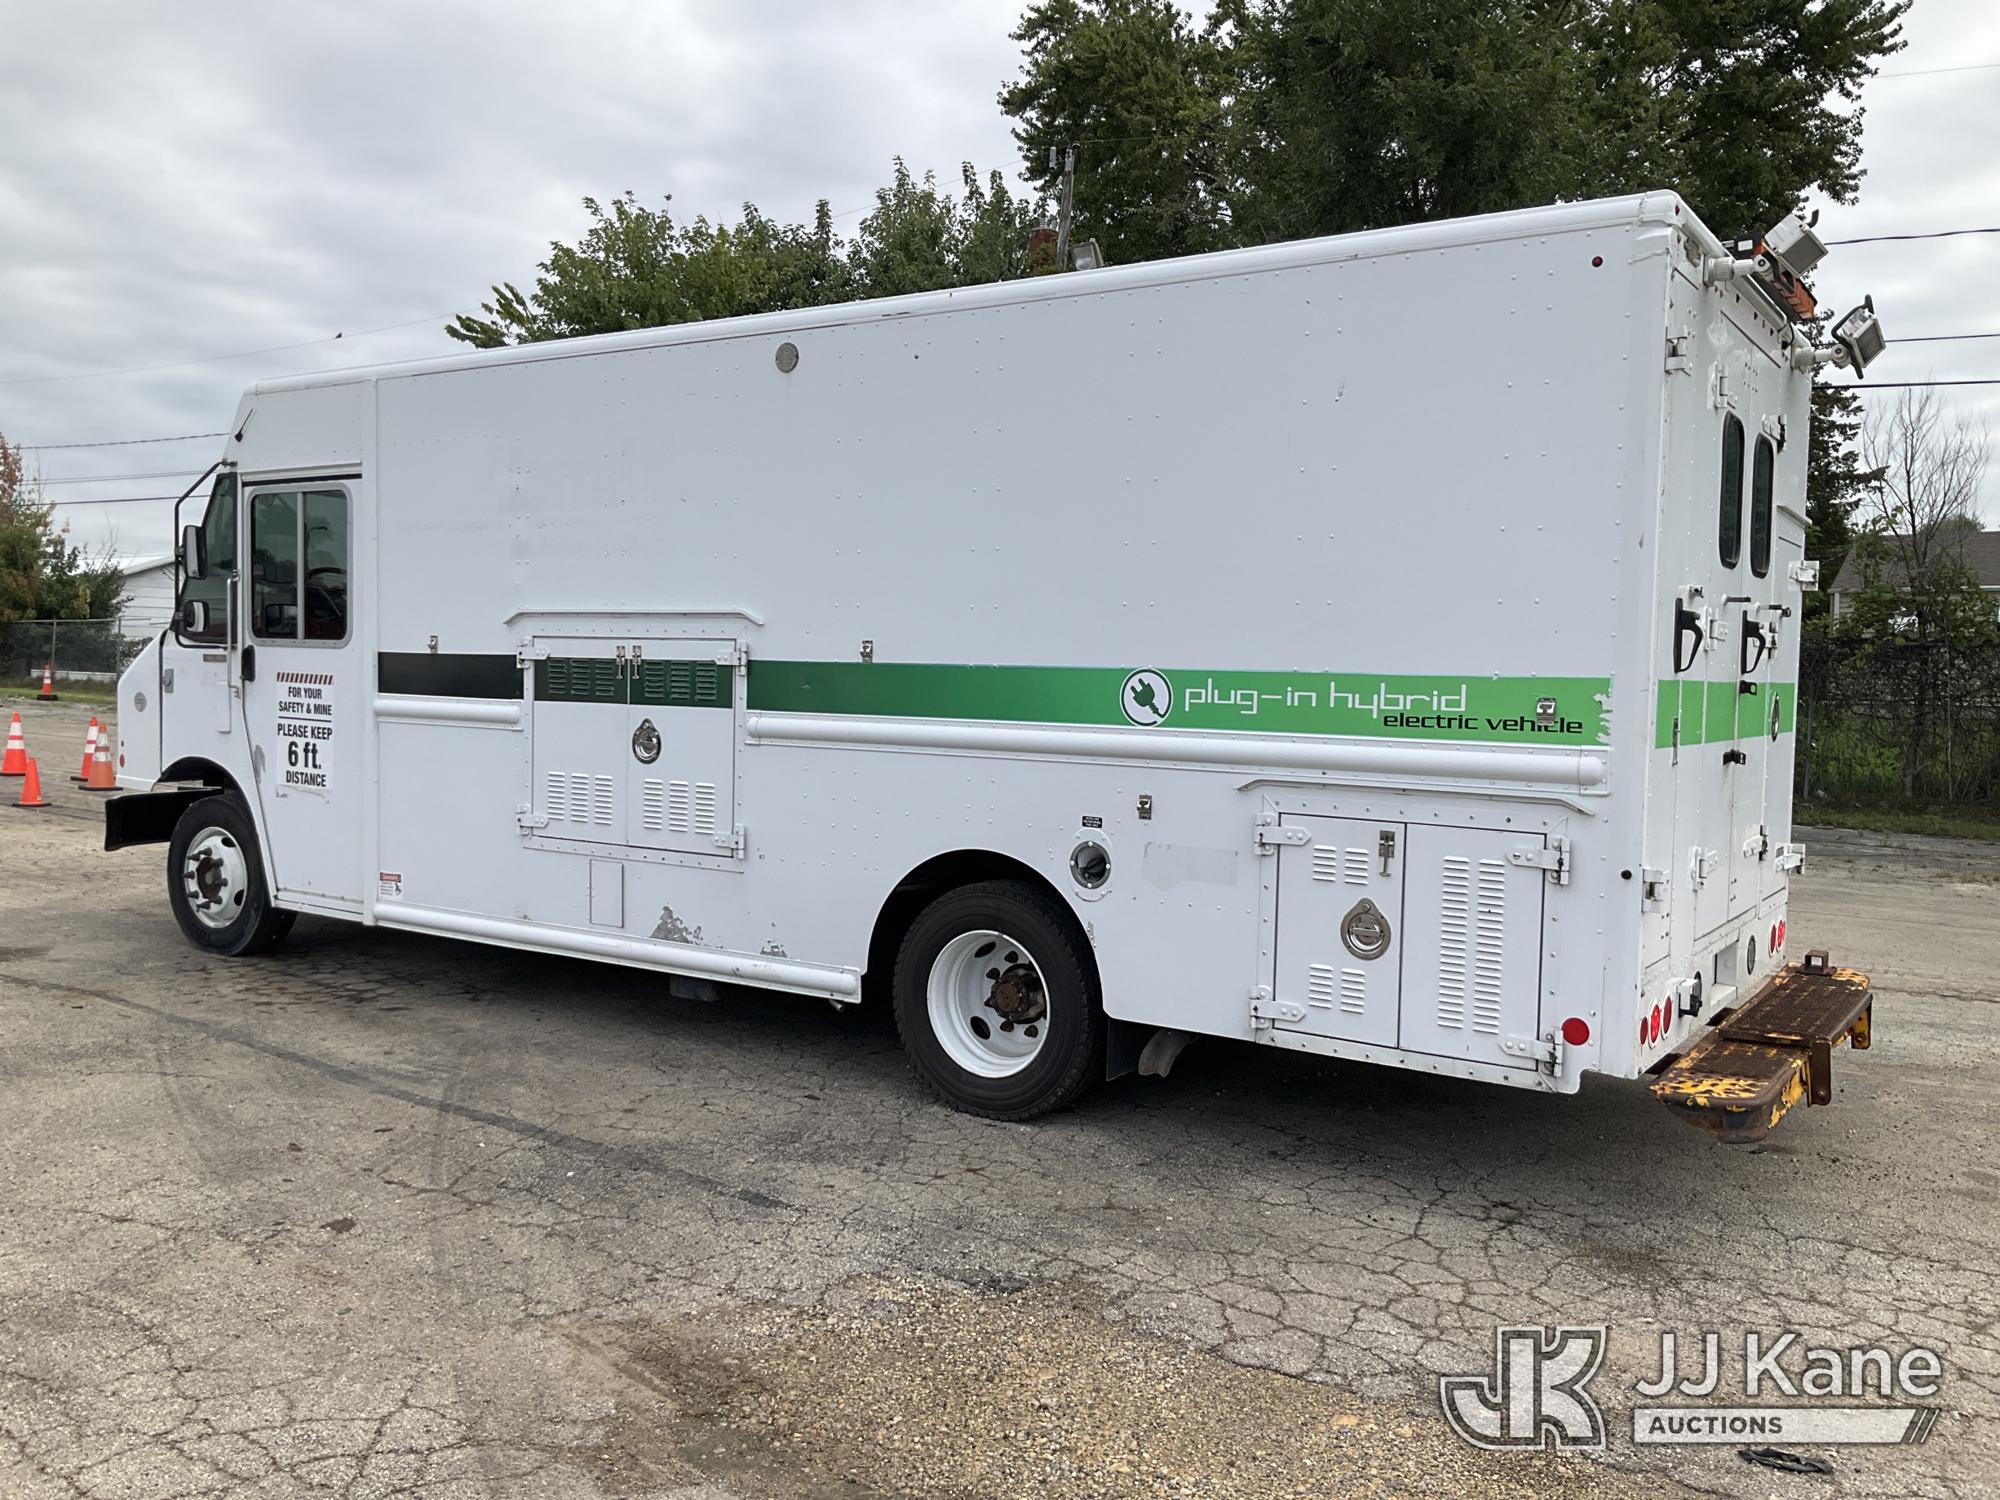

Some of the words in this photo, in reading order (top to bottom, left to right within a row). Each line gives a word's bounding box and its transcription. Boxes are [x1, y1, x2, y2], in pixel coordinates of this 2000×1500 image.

[288, 686, 302, 698] FOR
[303, 688, 322, 699] YOUR
[1184, 678, 1316, 714] plug-in
[1329, 682, 1467, 719] hybrid
[278, 701, 304, 714] SAFETY
[305, 703, 312, 714] &
[313, 703, 332, 716] MINE
[277, 723, 308, 738] PLEASE
[310, 726, 333, 740] KEEP
[1383, 713, 1478, 730] electric
[1486, 716, 1583, 734] vehcle
[288, 741, 299, 767] 6
[303, 742, 322, 770] ft.
[286, 770, 326, 787] DISTANCE
